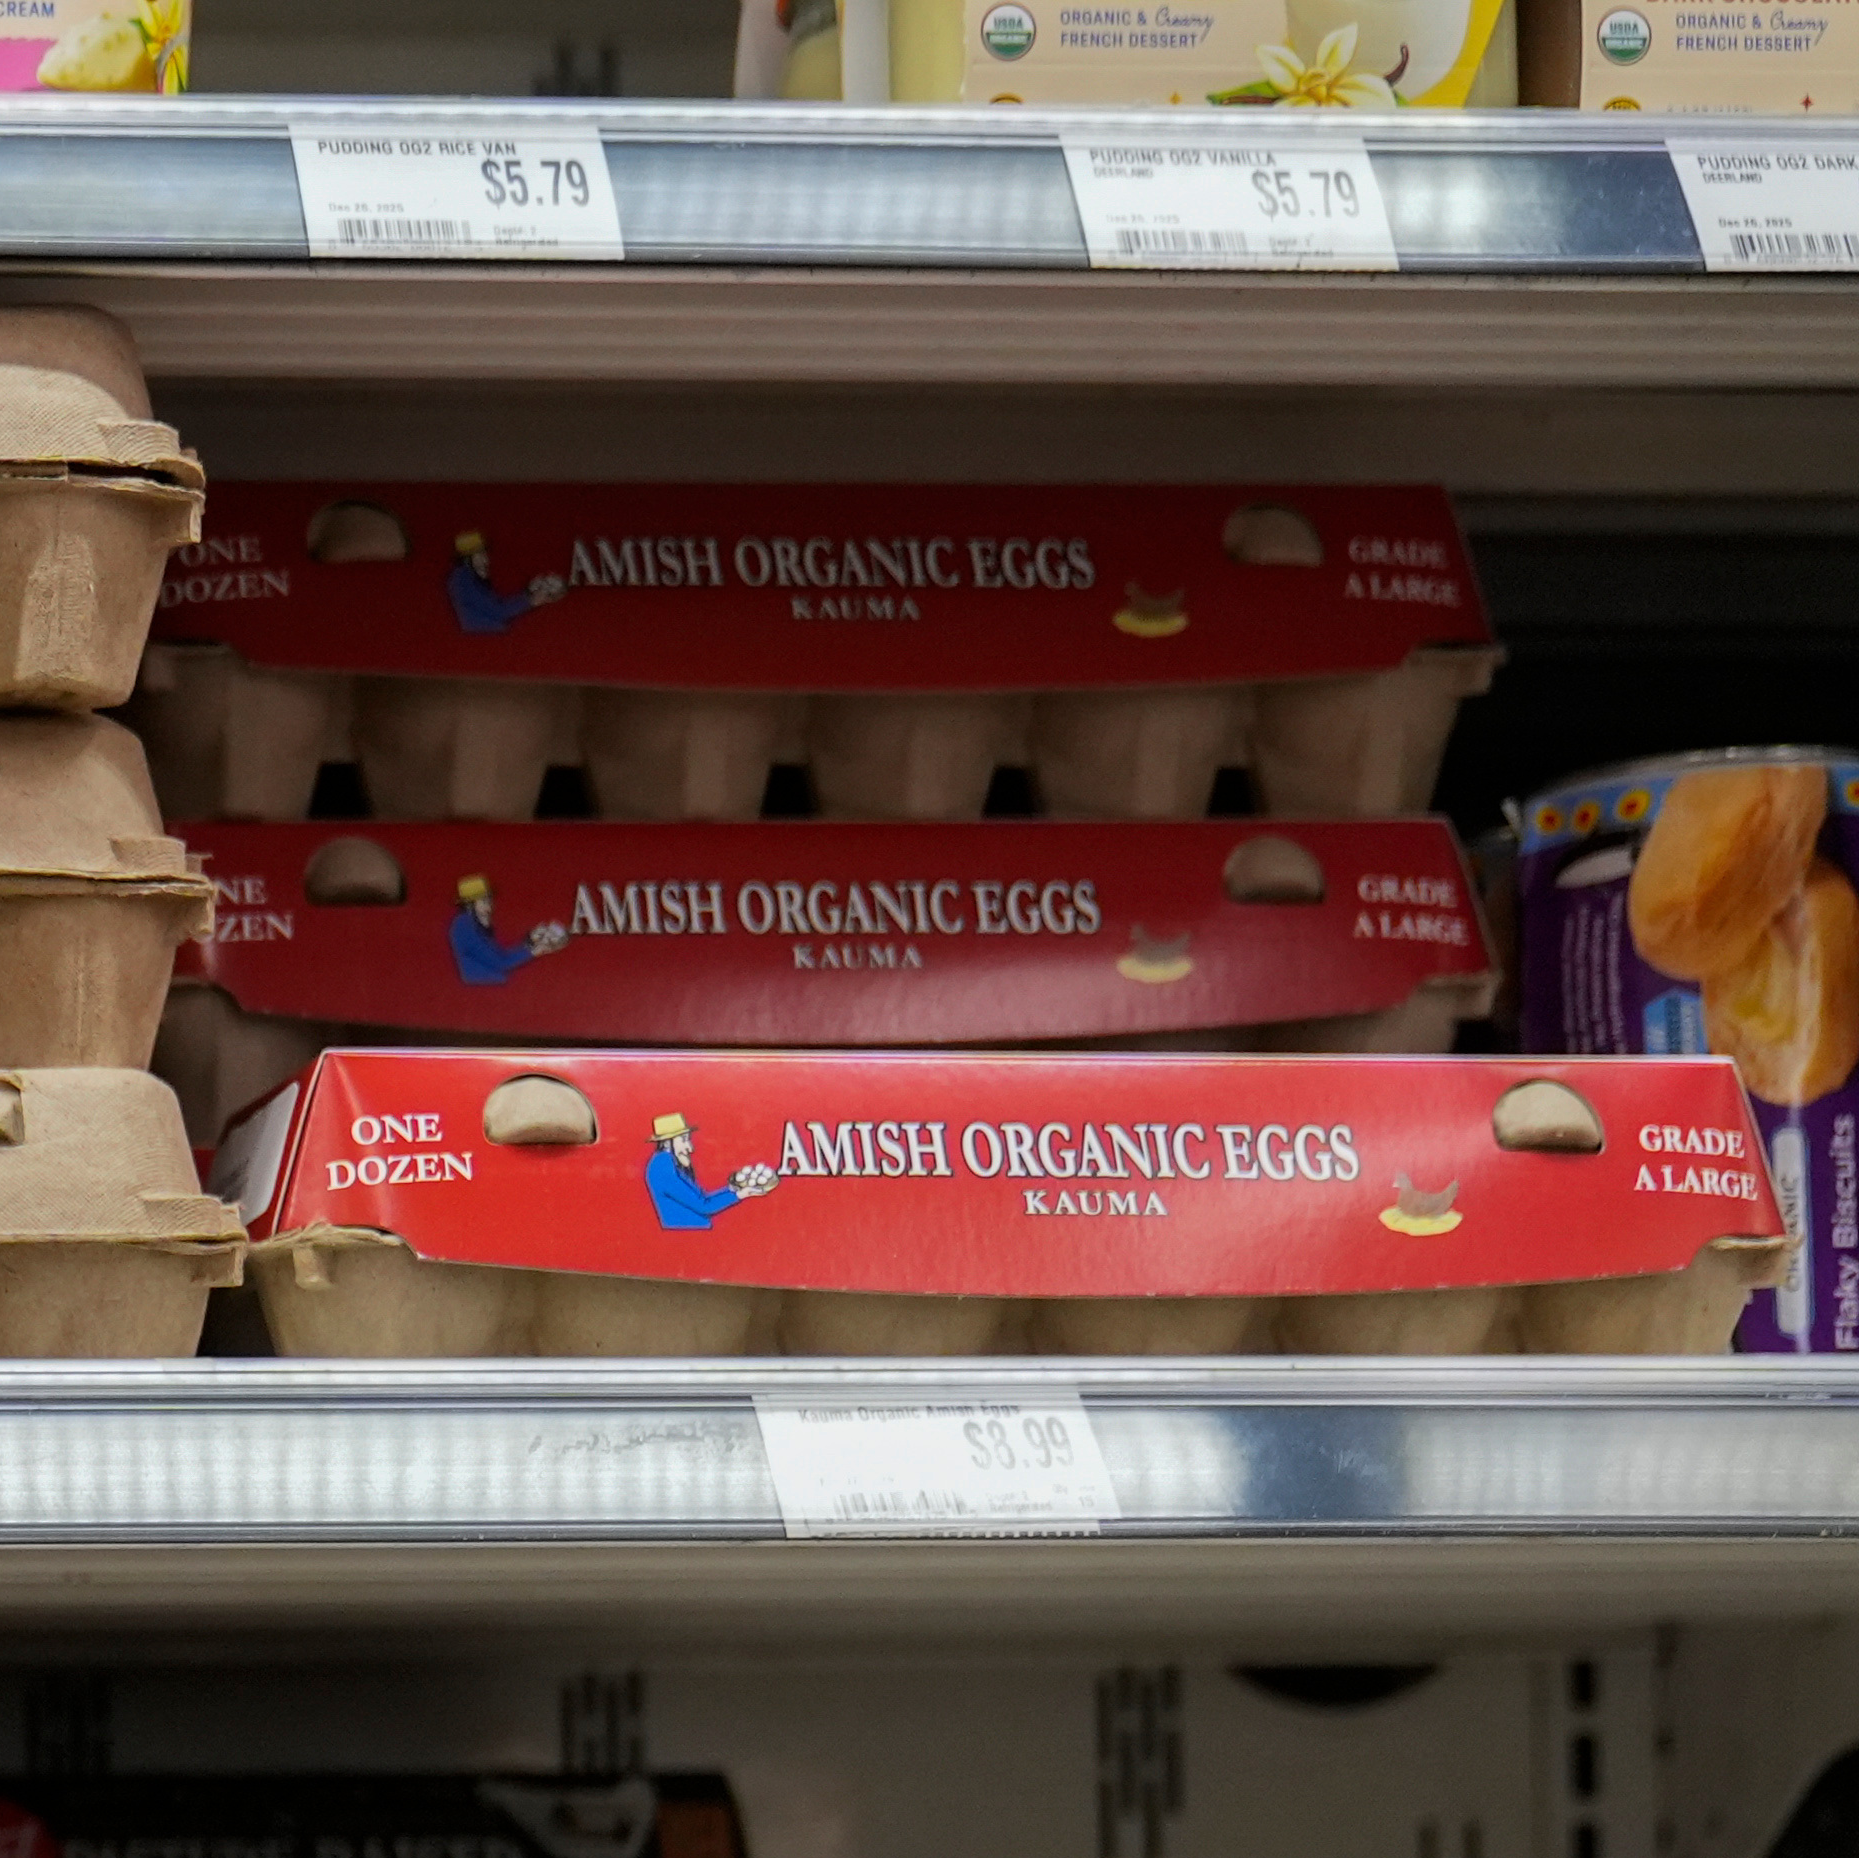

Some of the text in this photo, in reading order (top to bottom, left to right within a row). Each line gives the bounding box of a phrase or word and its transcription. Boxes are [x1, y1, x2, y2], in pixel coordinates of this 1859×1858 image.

[1060, 7, 1214, 43] ORGANIC Creamy
[1060, 33, 1198, 48] FRENCH DESSERT
[318, 141, 393, 155] PUDDING
[481, 159, 590, 208] $5.79
[1251, 169, 1361, 218] $5.79
[568, 535, 1095, 591] AMISH ORGANIC EGGS
[570, 881, 1101, 935] AMISH ORGANIC EGGS
[792, 945, 922, 970] KAUMA
[350, 1112, 443, 1149] ONE
[1639, 1124, 1745, 1160] GRADE
[326, 1148, 474, 1192] DOZEN
[778, 1120, 1360, 1182] AMISH ORGANIC EGGS
[1662, 1165, 1758, 1201] LARGE
[1830, 1113, 1857, 1250] Biscuits
[1023, 1188, 1169, 1218] KAUMA
[964, 1417, 1075, 1471] $8.99
